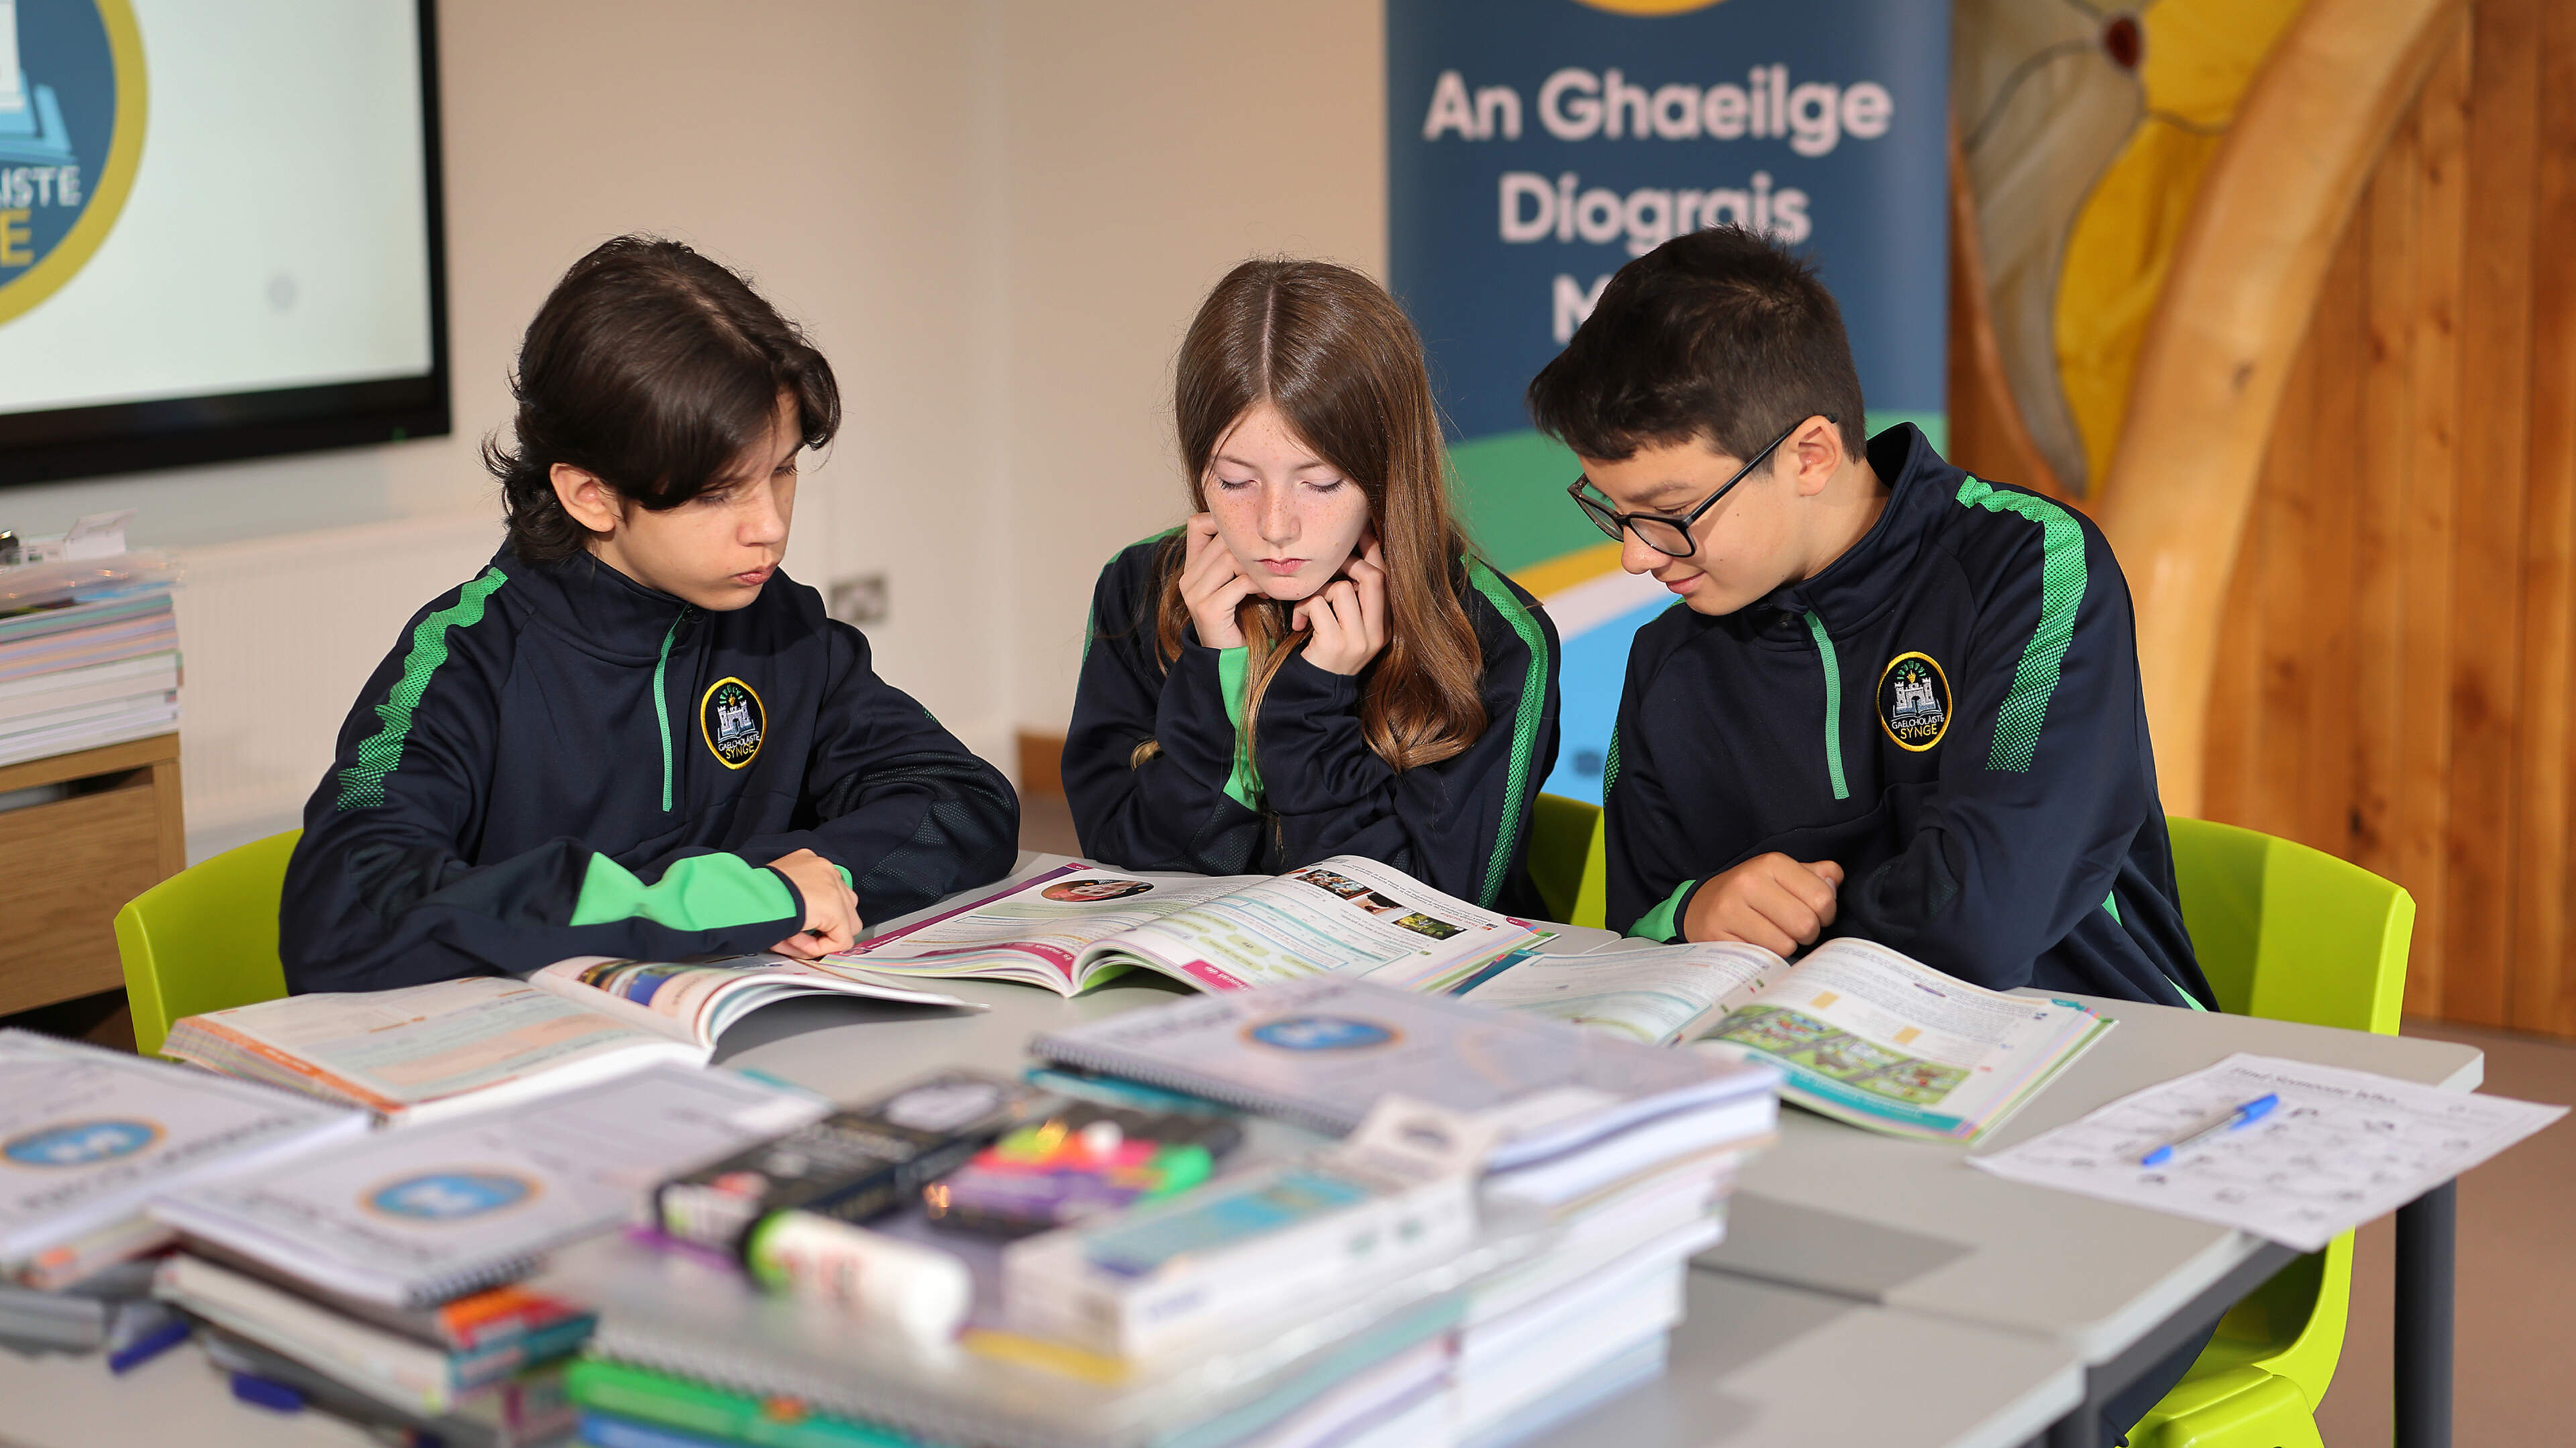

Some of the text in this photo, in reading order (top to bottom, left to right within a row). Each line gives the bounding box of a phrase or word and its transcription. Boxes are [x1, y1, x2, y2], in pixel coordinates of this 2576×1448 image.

[1423, 63, 1894, 156] An Ghaeilge
[0, 166, 81, 208] ISTE
[1900, 724, 1937, 739] SYNGE
[726, 741, 755, 759] SYNGE
